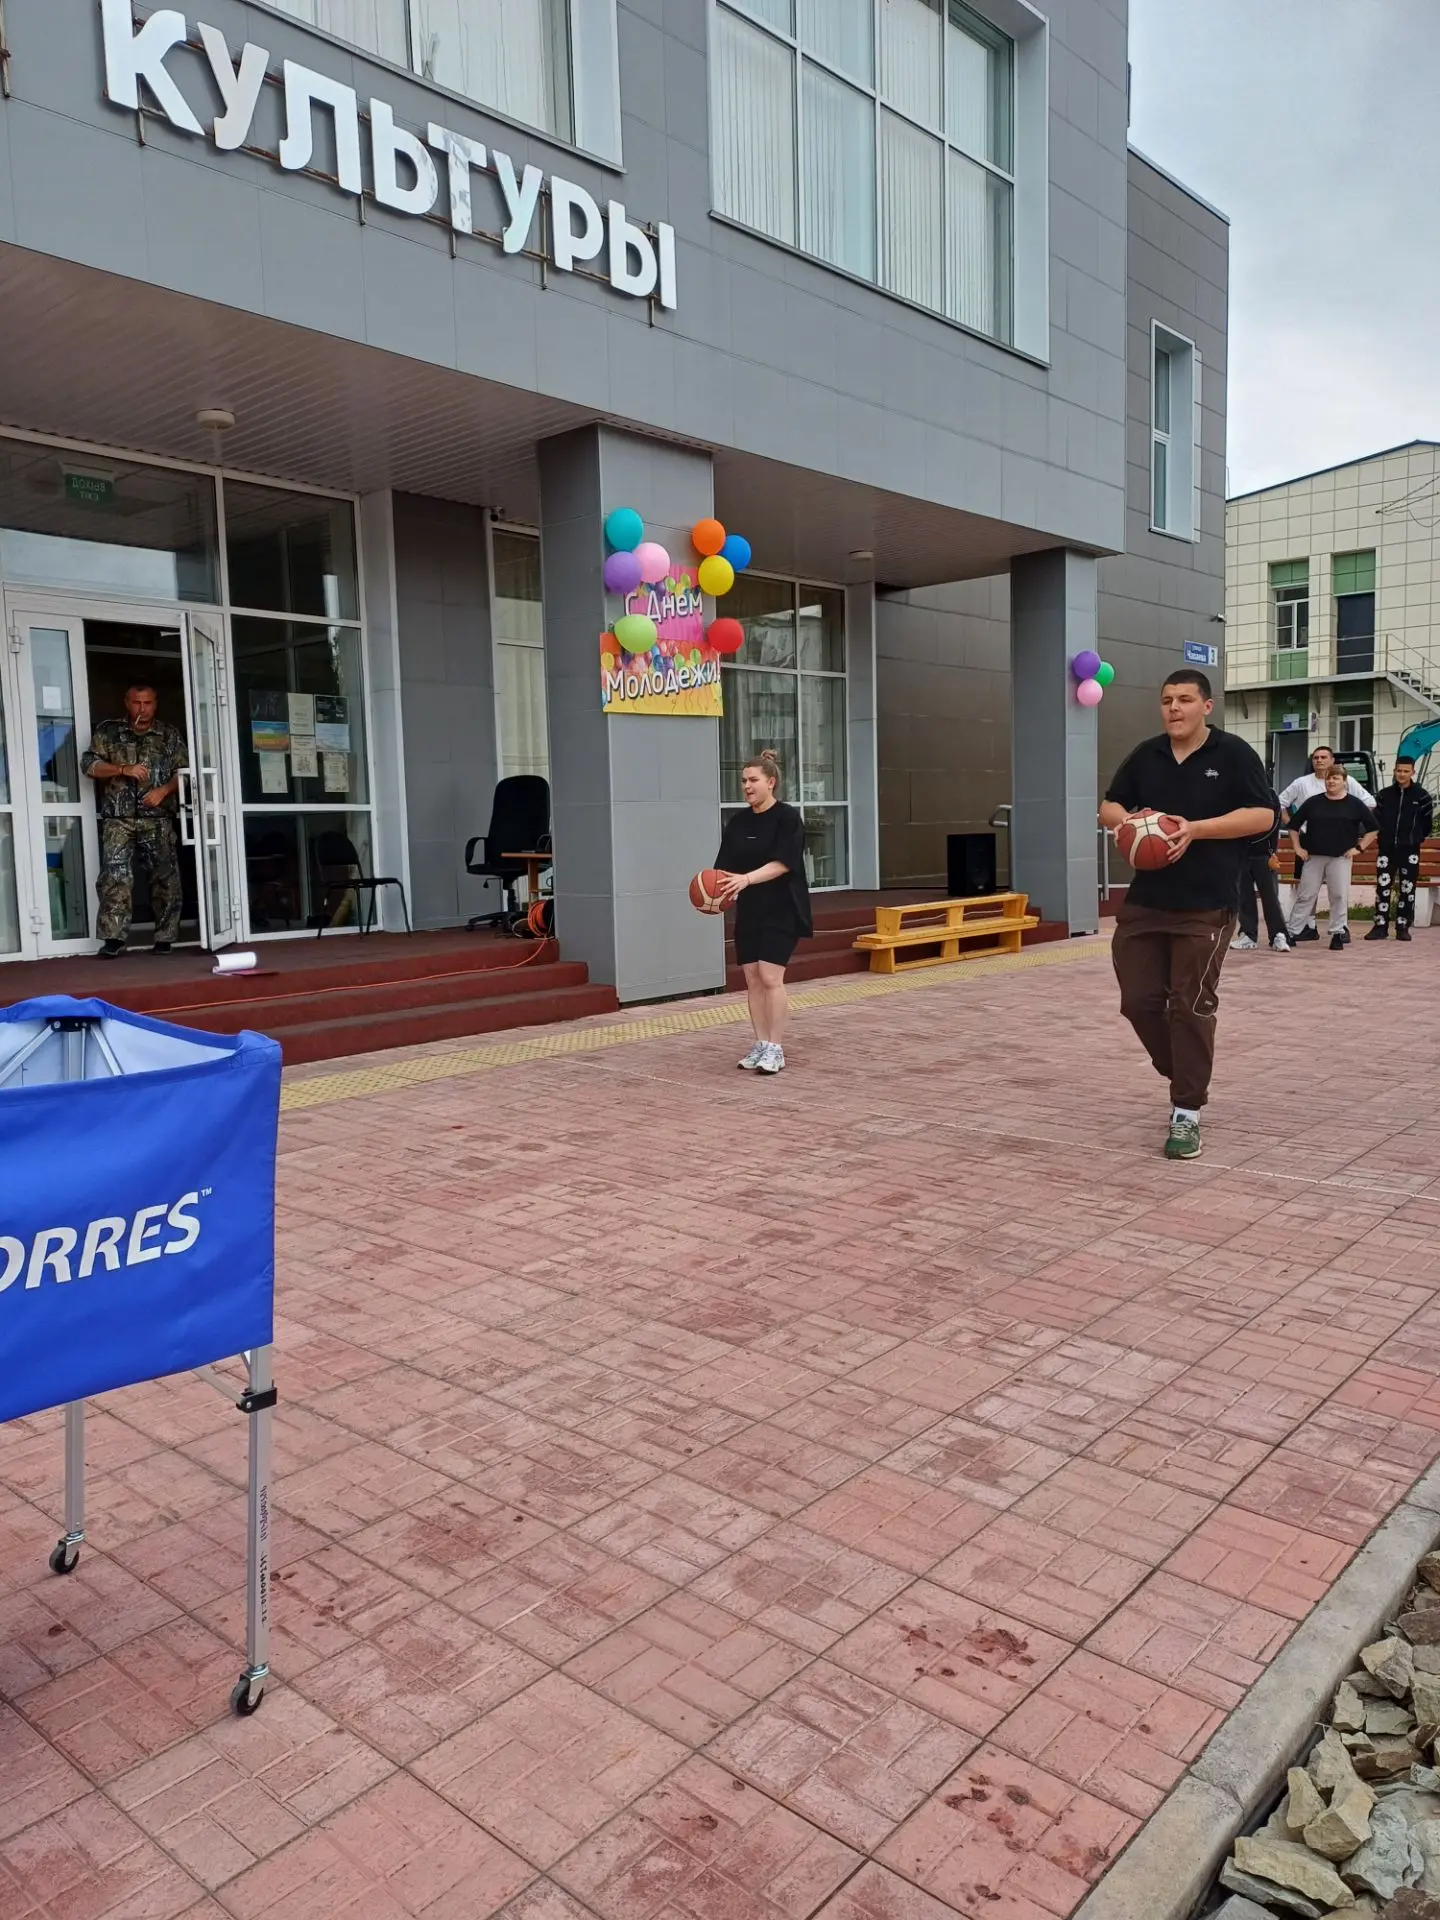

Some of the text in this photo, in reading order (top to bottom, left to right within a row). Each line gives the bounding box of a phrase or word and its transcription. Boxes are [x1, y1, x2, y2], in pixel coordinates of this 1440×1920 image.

[101, 0, 678, 310] КУЛЬТУРЫ
[625, 590, 703, 623] С Днем
[606, 655, 721, 702] Молодежи!
